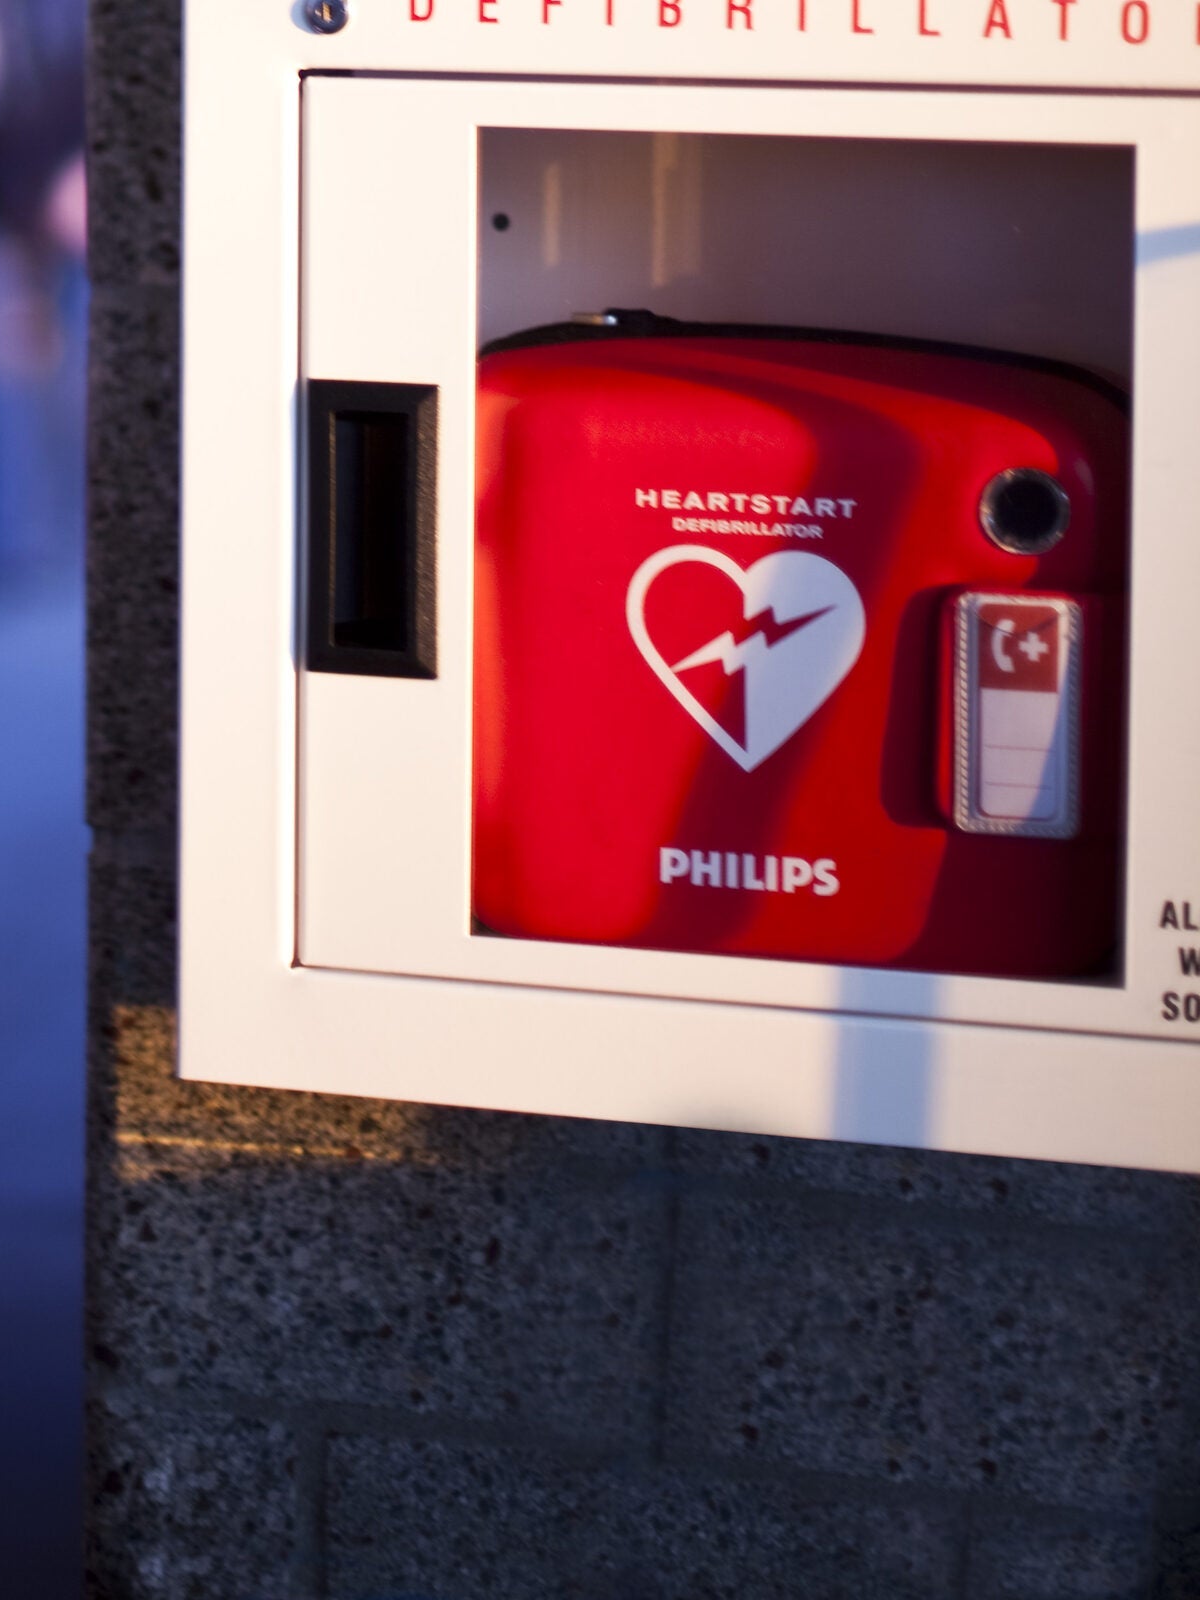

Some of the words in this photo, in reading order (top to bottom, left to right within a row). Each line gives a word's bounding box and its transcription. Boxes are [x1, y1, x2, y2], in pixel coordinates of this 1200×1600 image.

[409, 0, 1200, 46] DEFIBRILLATO
[634, 488, 857, 519] HEARTSTART
[672, 516, 824, 539] DEFIBRILLATOR
[659, 847, 840, 896] PHILIPS
